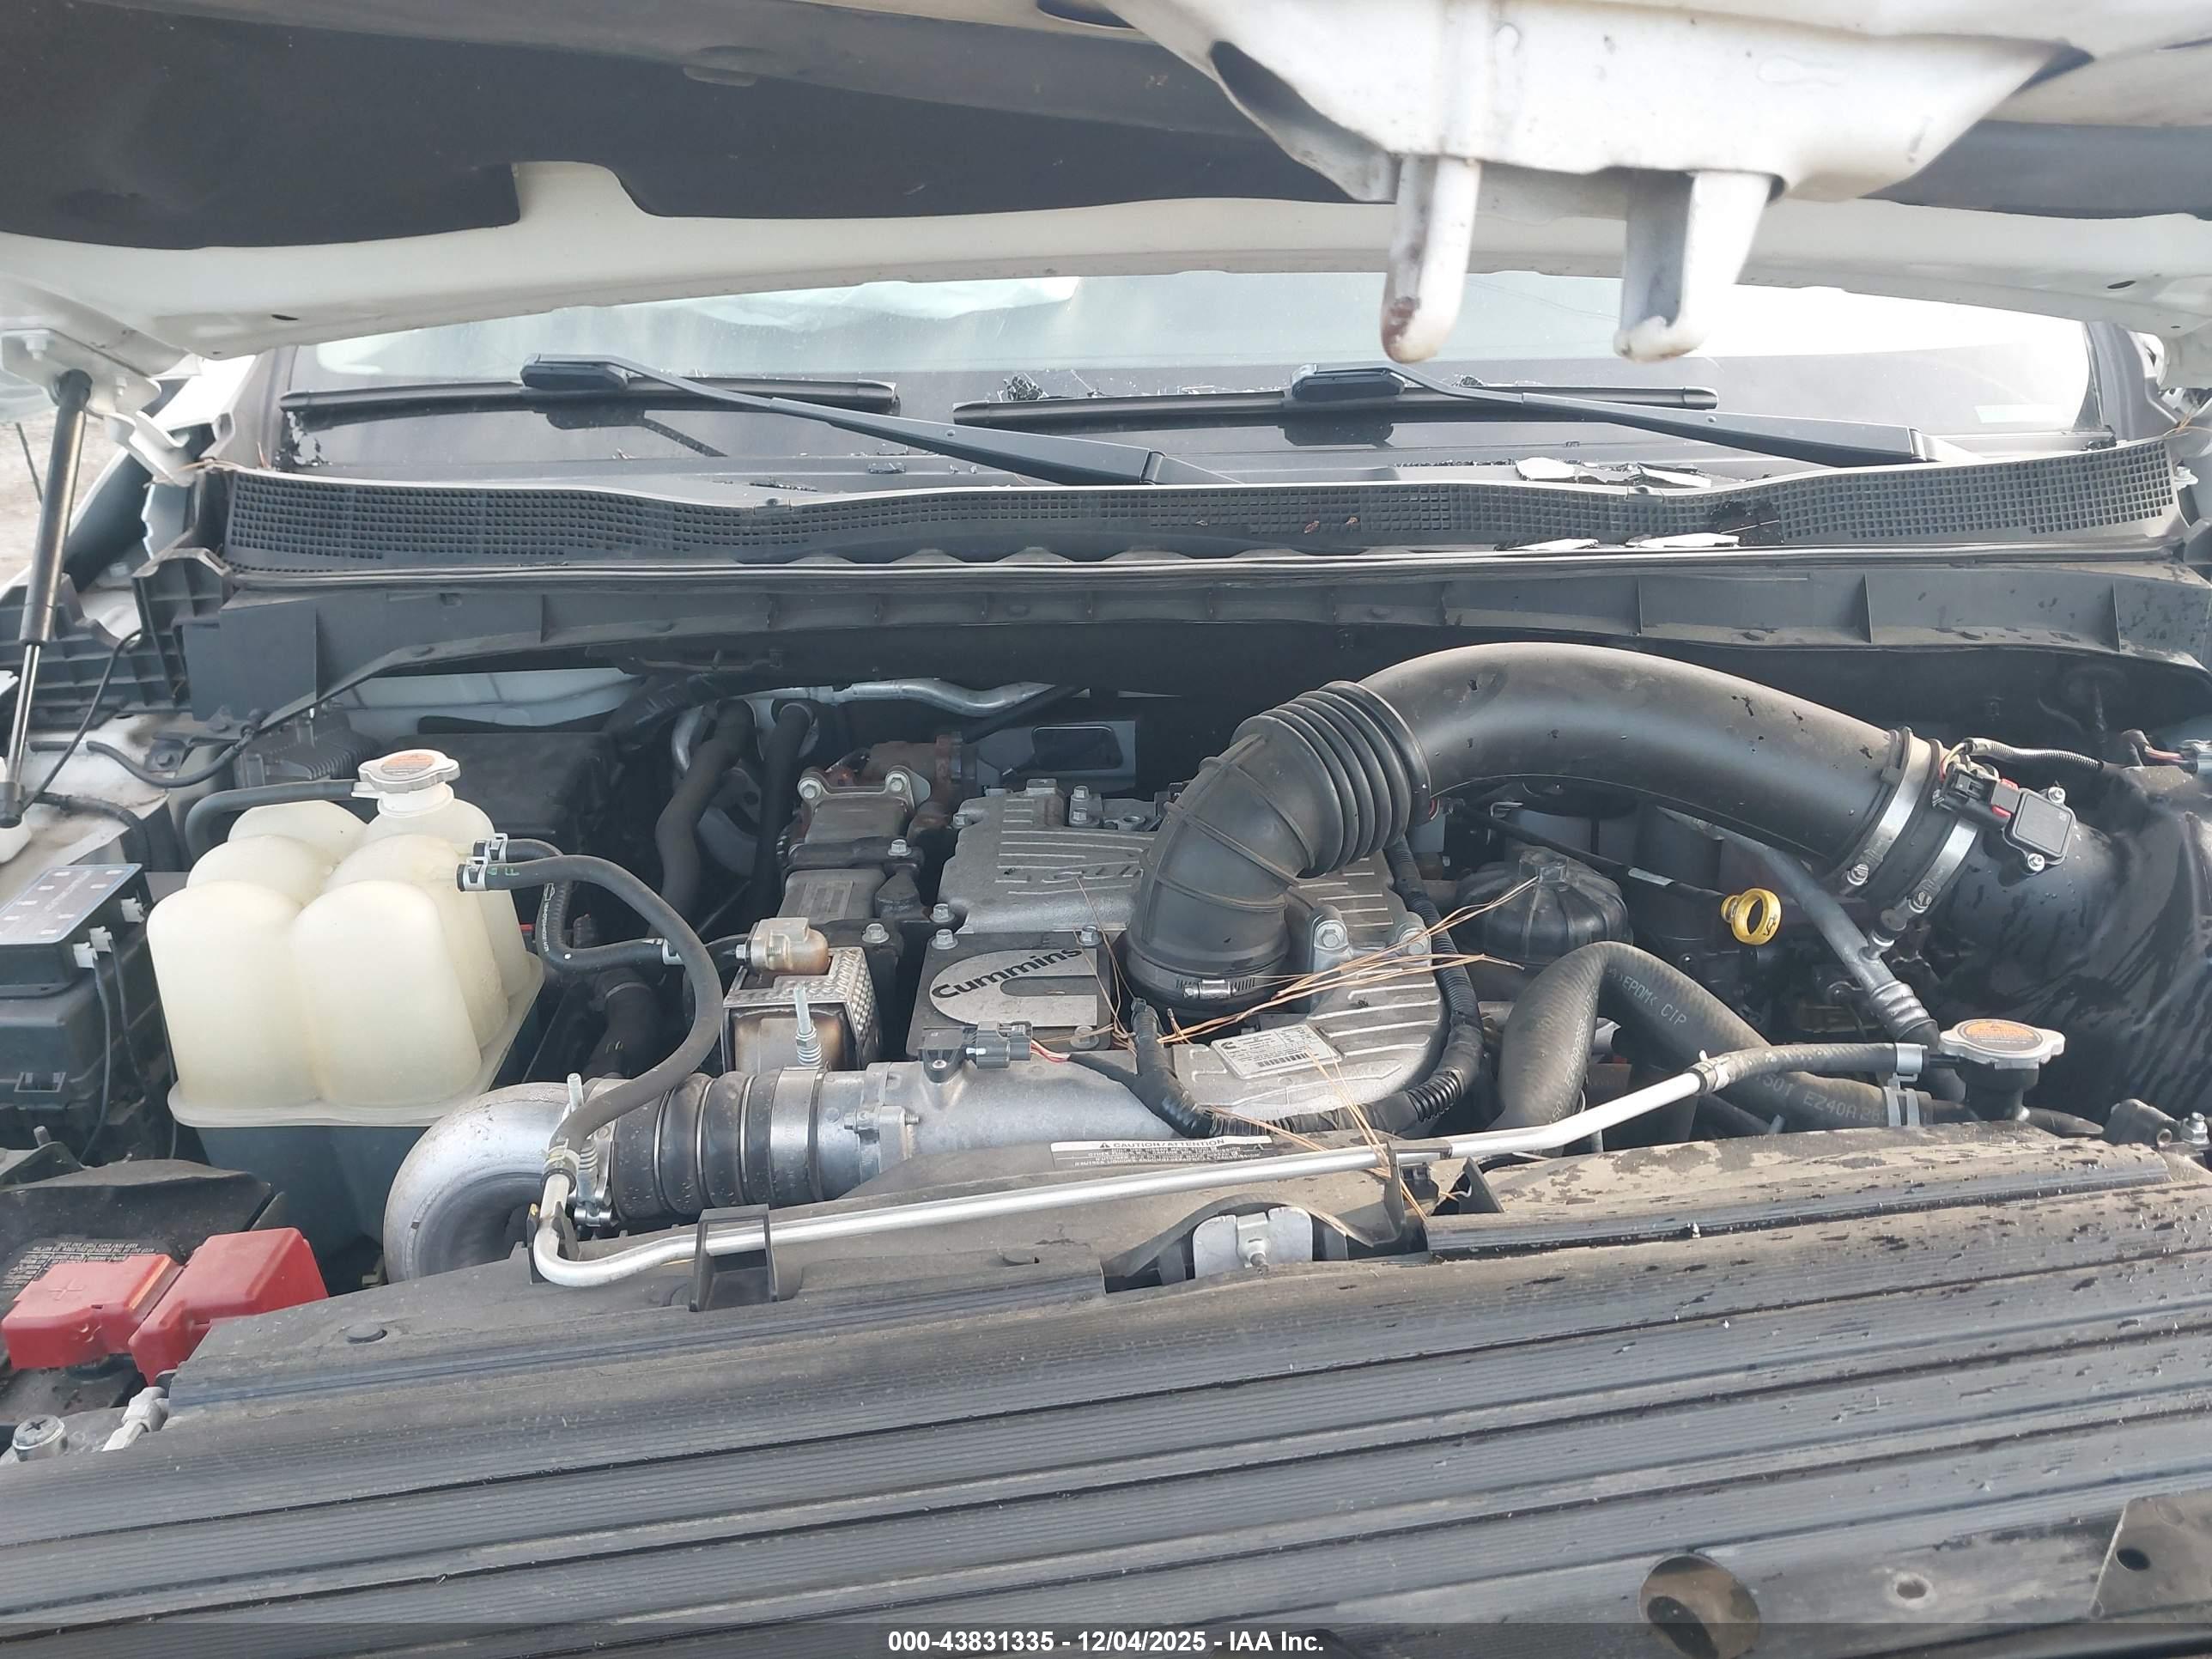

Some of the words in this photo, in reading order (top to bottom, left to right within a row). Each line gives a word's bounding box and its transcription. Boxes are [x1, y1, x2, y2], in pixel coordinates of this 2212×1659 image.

[931, 948, 1084, 999] Cummins
[1660, 1003, 1687, 1024] CIP
[1113, 1138, 1225, 1149] CAUTION/ATTENTION
